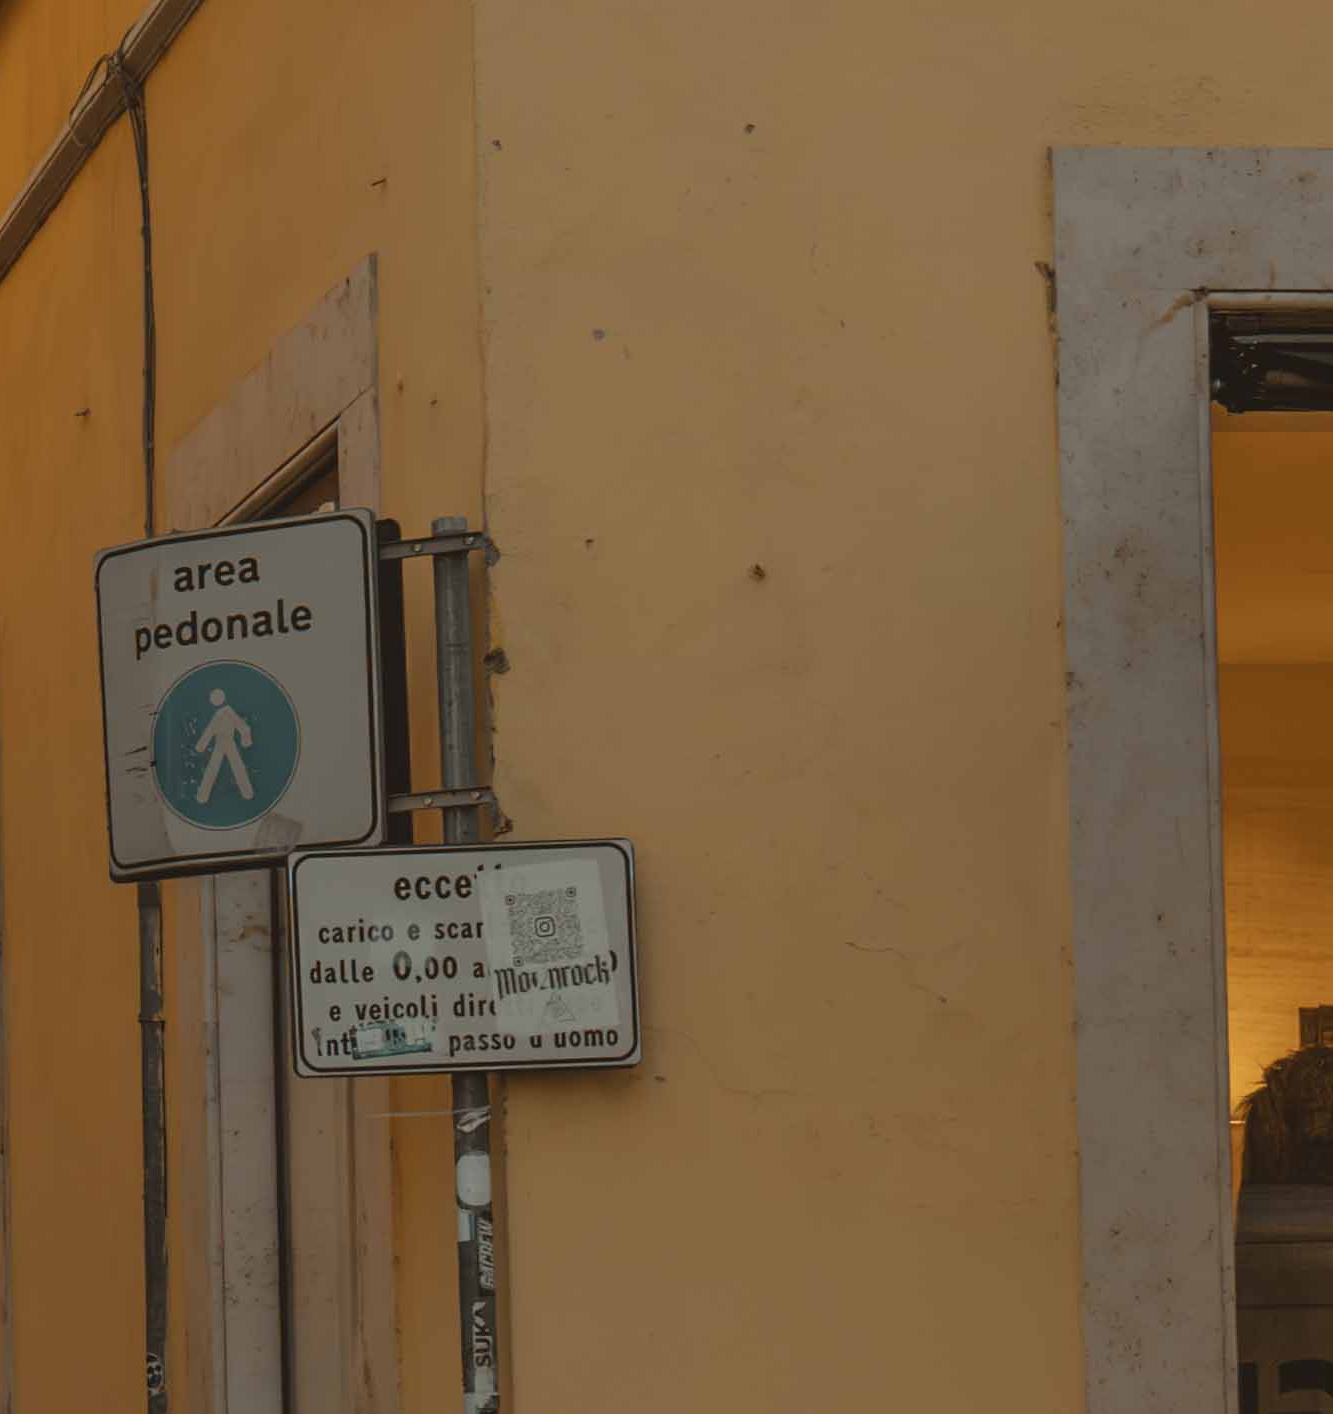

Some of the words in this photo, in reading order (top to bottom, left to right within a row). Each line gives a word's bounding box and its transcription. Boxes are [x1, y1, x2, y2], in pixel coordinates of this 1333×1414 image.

[173, 555, 260, 593] area
[133, 597, 313, 661] pedonale
[317, 918, 395, 944] carico
[408, 922, 421, 941] e
[309, 960, 375, 985] dalle
[392, 949, 458, 983] 0,00
[329, 1004, 341, 1022] e
[354, 993, 438, 1020] veicoli
[448, 1032, 516, 1057] passo
